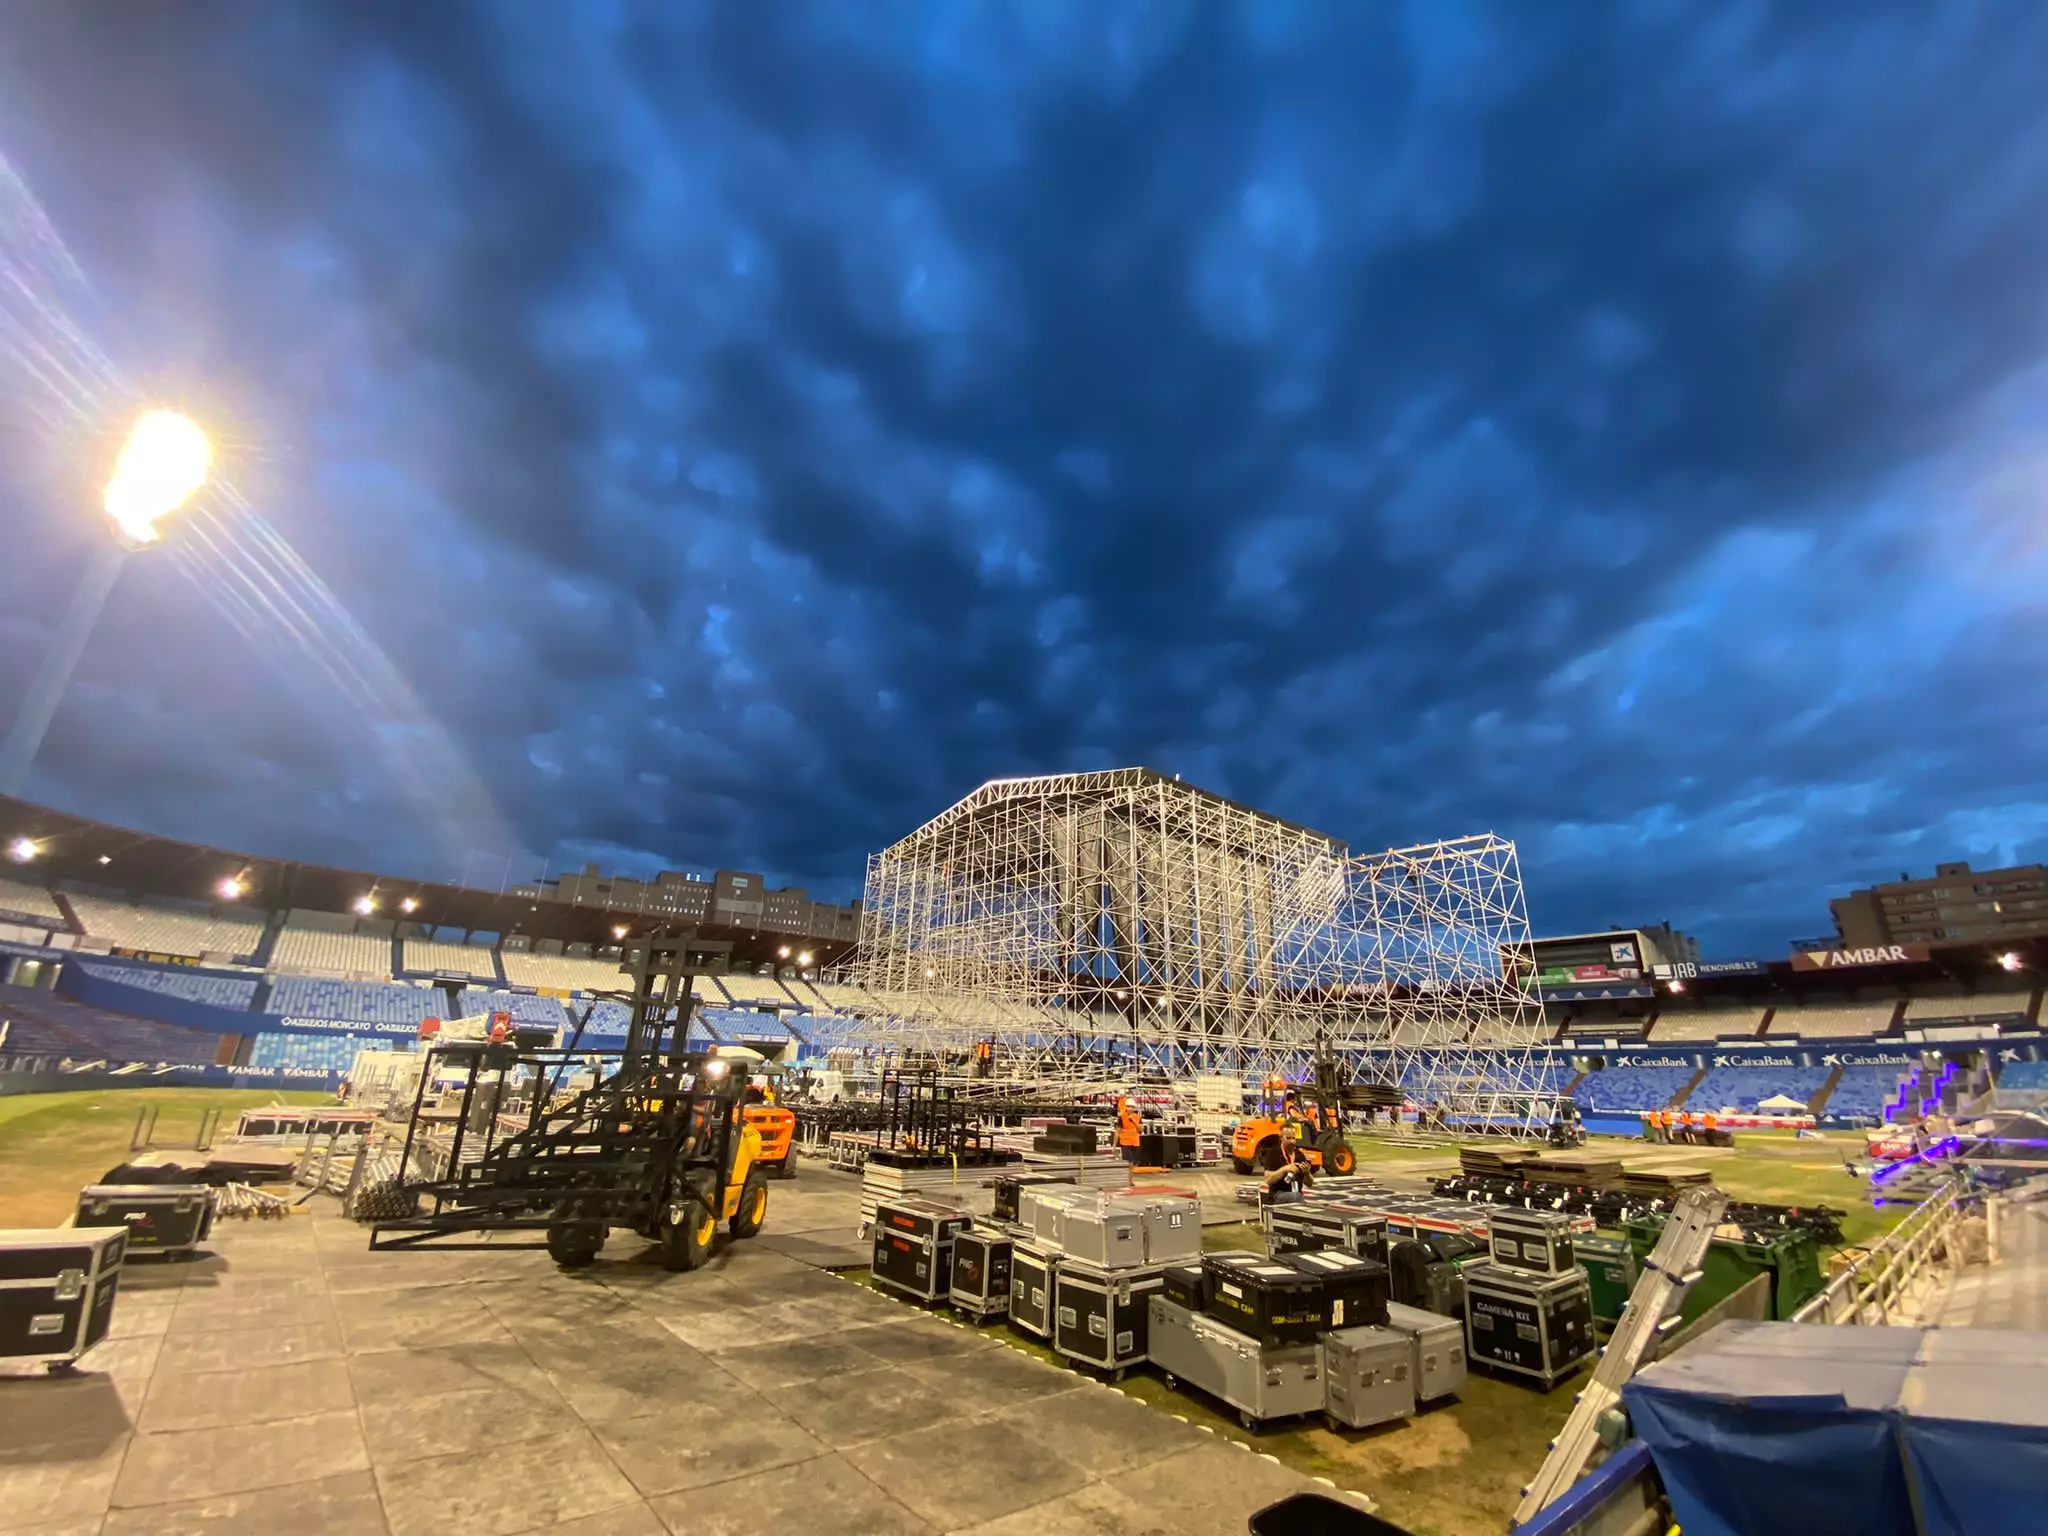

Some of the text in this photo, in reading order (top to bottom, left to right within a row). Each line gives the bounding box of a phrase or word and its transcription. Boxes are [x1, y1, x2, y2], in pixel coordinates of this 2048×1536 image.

[1832, 945, 1909, 966] AMBAR
[1673, 961, 1758, 978] JAB RENOVABLES
[329, 1020, 371, 1031] MONCAYO
[1518, 1055, 1566, 1067] CaixaBank
[1632, 1056, 1688, 1067] CaixaBank
[1730, 1055, 1794, 1067] CaixaBank
[1841, 1052, 1910, 1066] CaixaBank
[235, 1066, 275, 1077] AMBAR
[291, 1068, 329, 1078] AMBAR
[1476, 1301, 1532, 1322] CAMERA KIT
